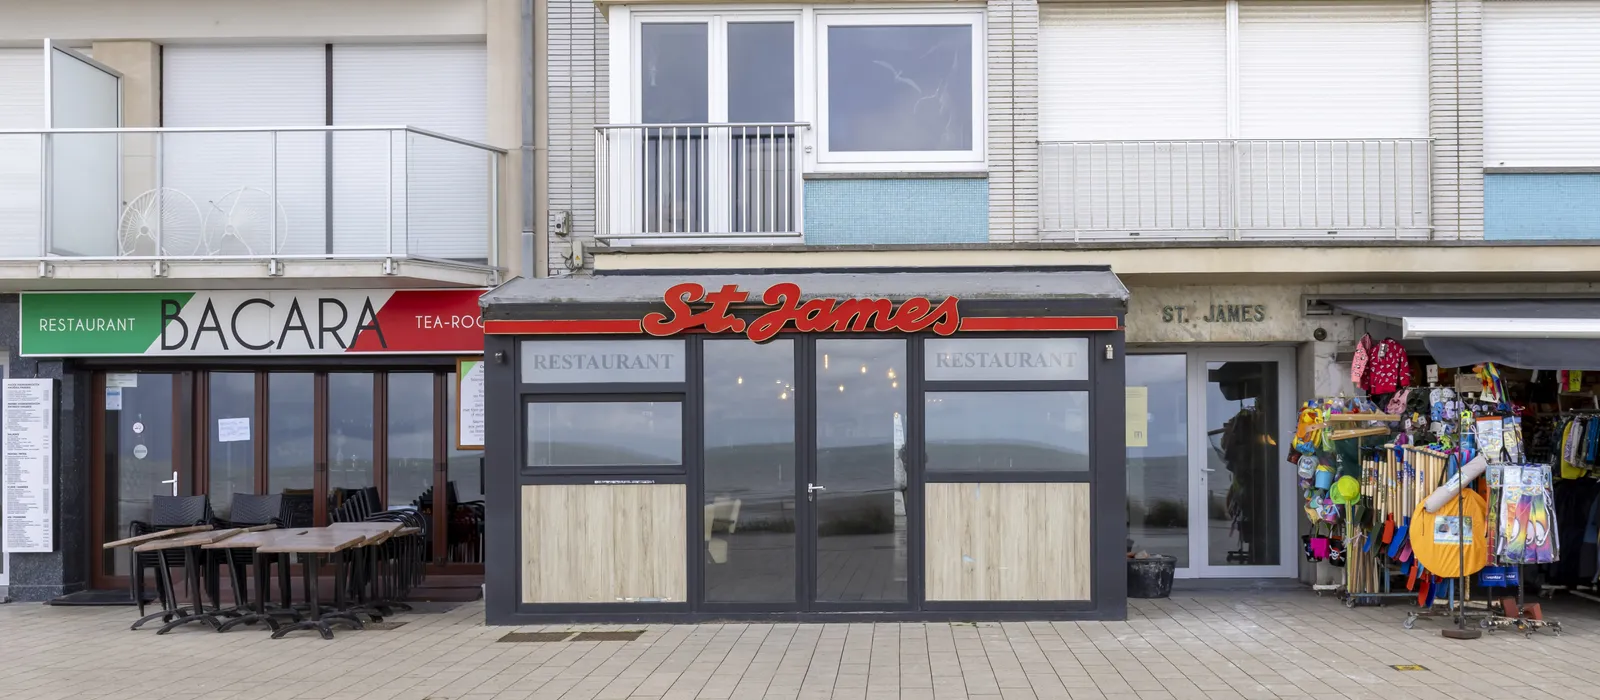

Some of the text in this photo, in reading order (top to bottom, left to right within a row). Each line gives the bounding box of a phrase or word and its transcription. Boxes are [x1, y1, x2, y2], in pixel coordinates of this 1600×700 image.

[641, 282, 960, 343] St. James
[1162, 304, 1266, 323] ST. JAMES
[39, 317, 136, 332] RESTAURANT
[161, 296, 388, 350] BACARA
[533, 353, 675, 370] RESTAURANT
[935, 352, 1077, 368] RESTAURANT
